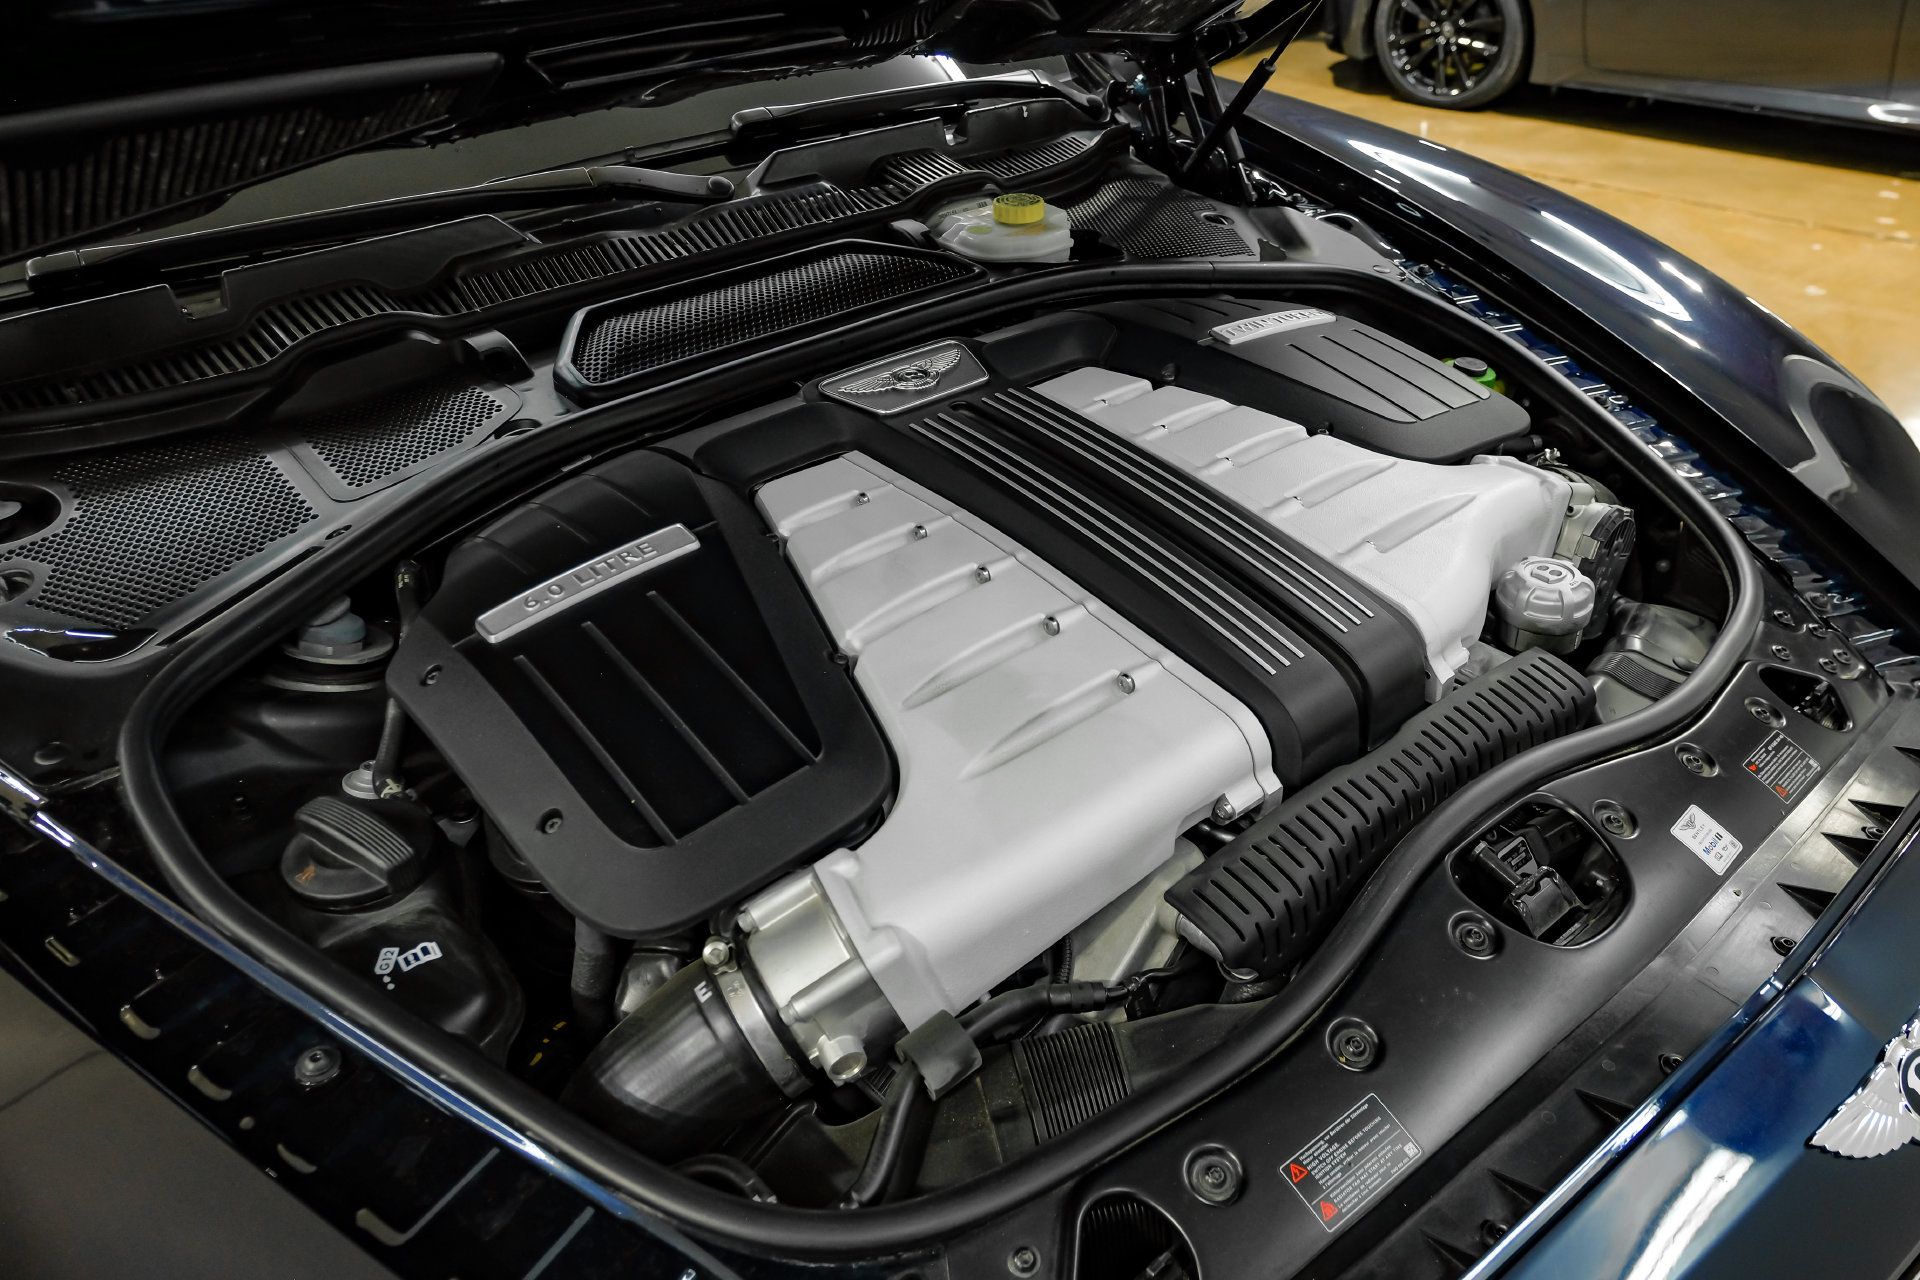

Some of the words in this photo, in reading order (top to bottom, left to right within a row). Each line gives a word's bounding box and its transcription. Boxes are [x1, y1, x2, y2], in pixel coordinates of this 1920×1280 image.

[523, 583, 566, 612] 6.0
[572, 542, 659, 587] LITRE
[1702, 837, 1718, 855] Mobil
[379, 950, 395, 971] G12
[1325, 1154, 1334, 1163] OFF
[1347, 1131, 1363, 1145] BEFORE
[1306, 1159, 1319, 1170] HIGH
